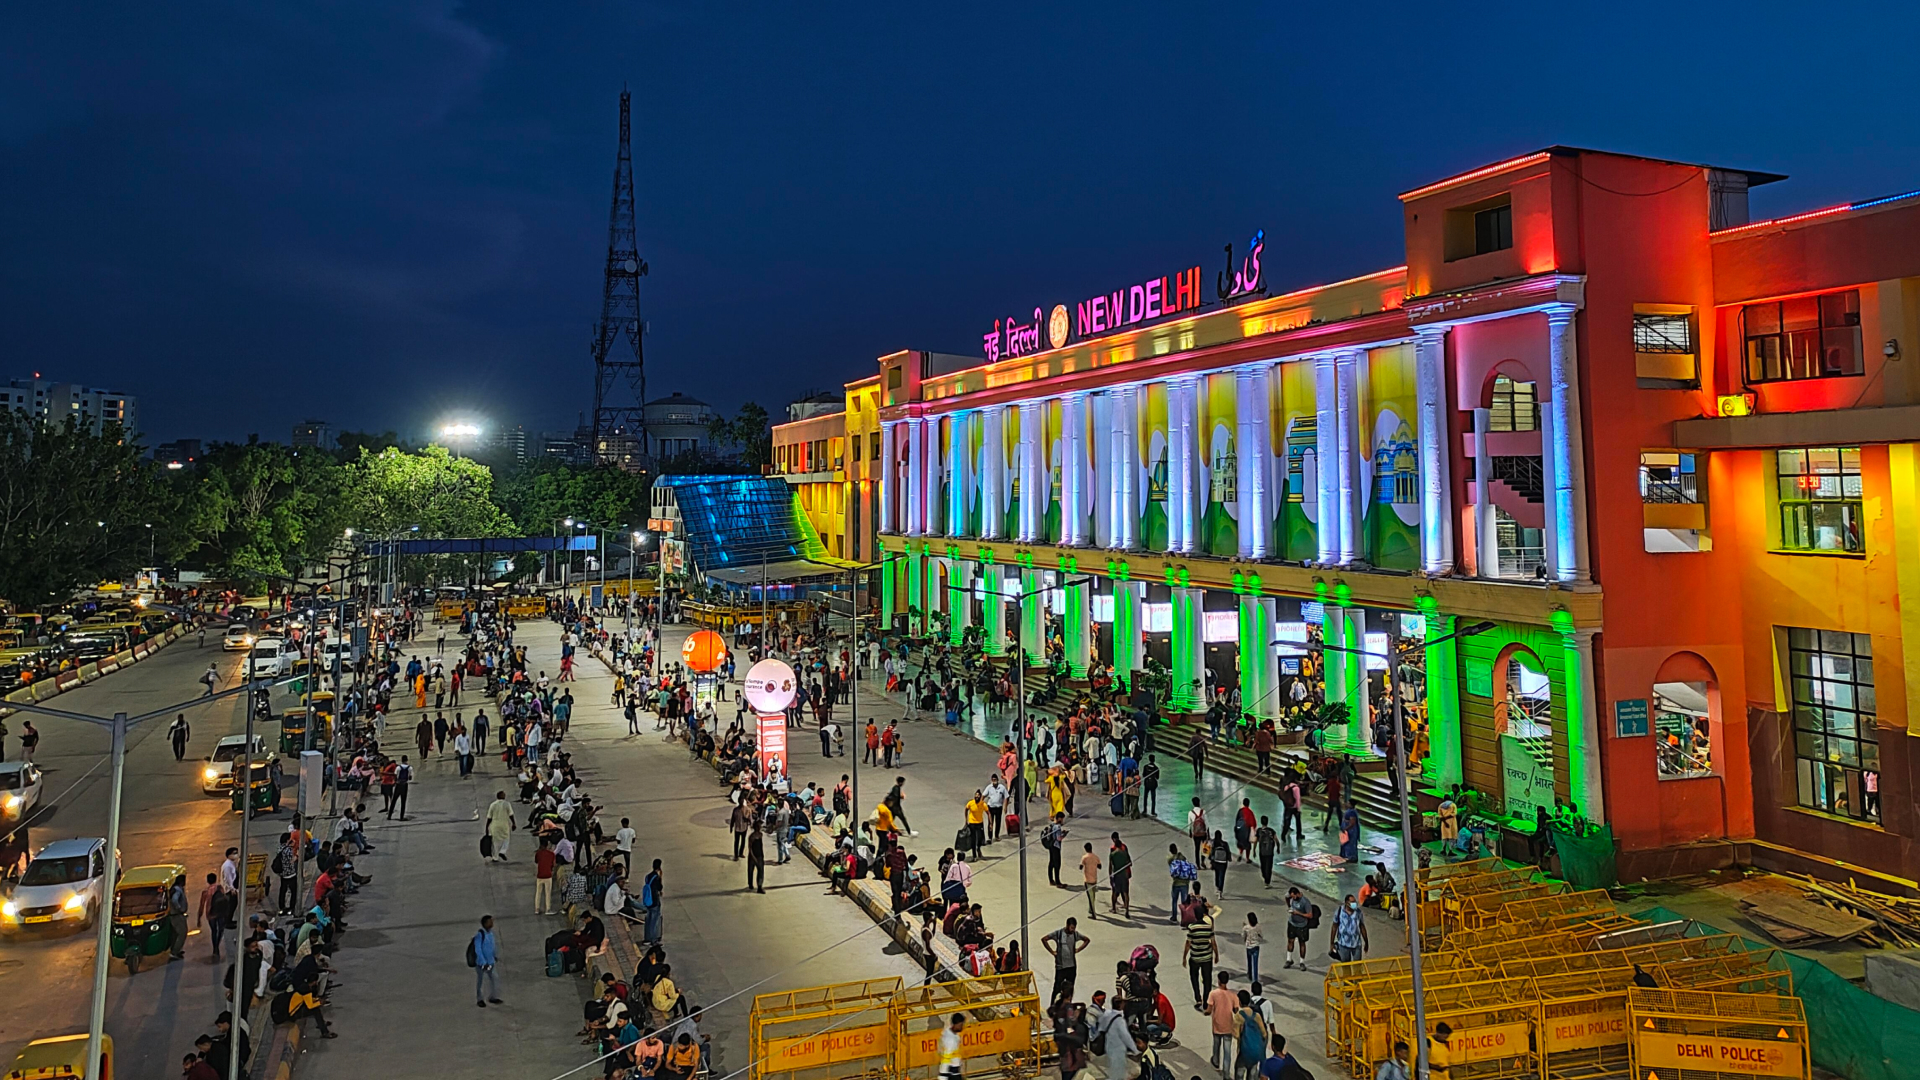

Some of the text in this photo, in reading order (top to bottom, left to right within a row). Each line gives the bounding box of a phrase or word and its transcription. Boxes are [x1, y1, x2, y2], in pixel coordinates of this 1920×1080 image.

[1078, 266, 1200, 336] NEW DELHI
[984, 307, 1043, 362] नई दिल्ली
[962, 1030, 991, 1047] OLICE
[1555, 1019, 1623, 1040] DELHI POLICE
[782, 1034, 861, 1057] DELHI POLICE
[1458, 1034, 1494, 1052] POLICE
[1677, 1043, 1767, 1063] DELHI POLICE
